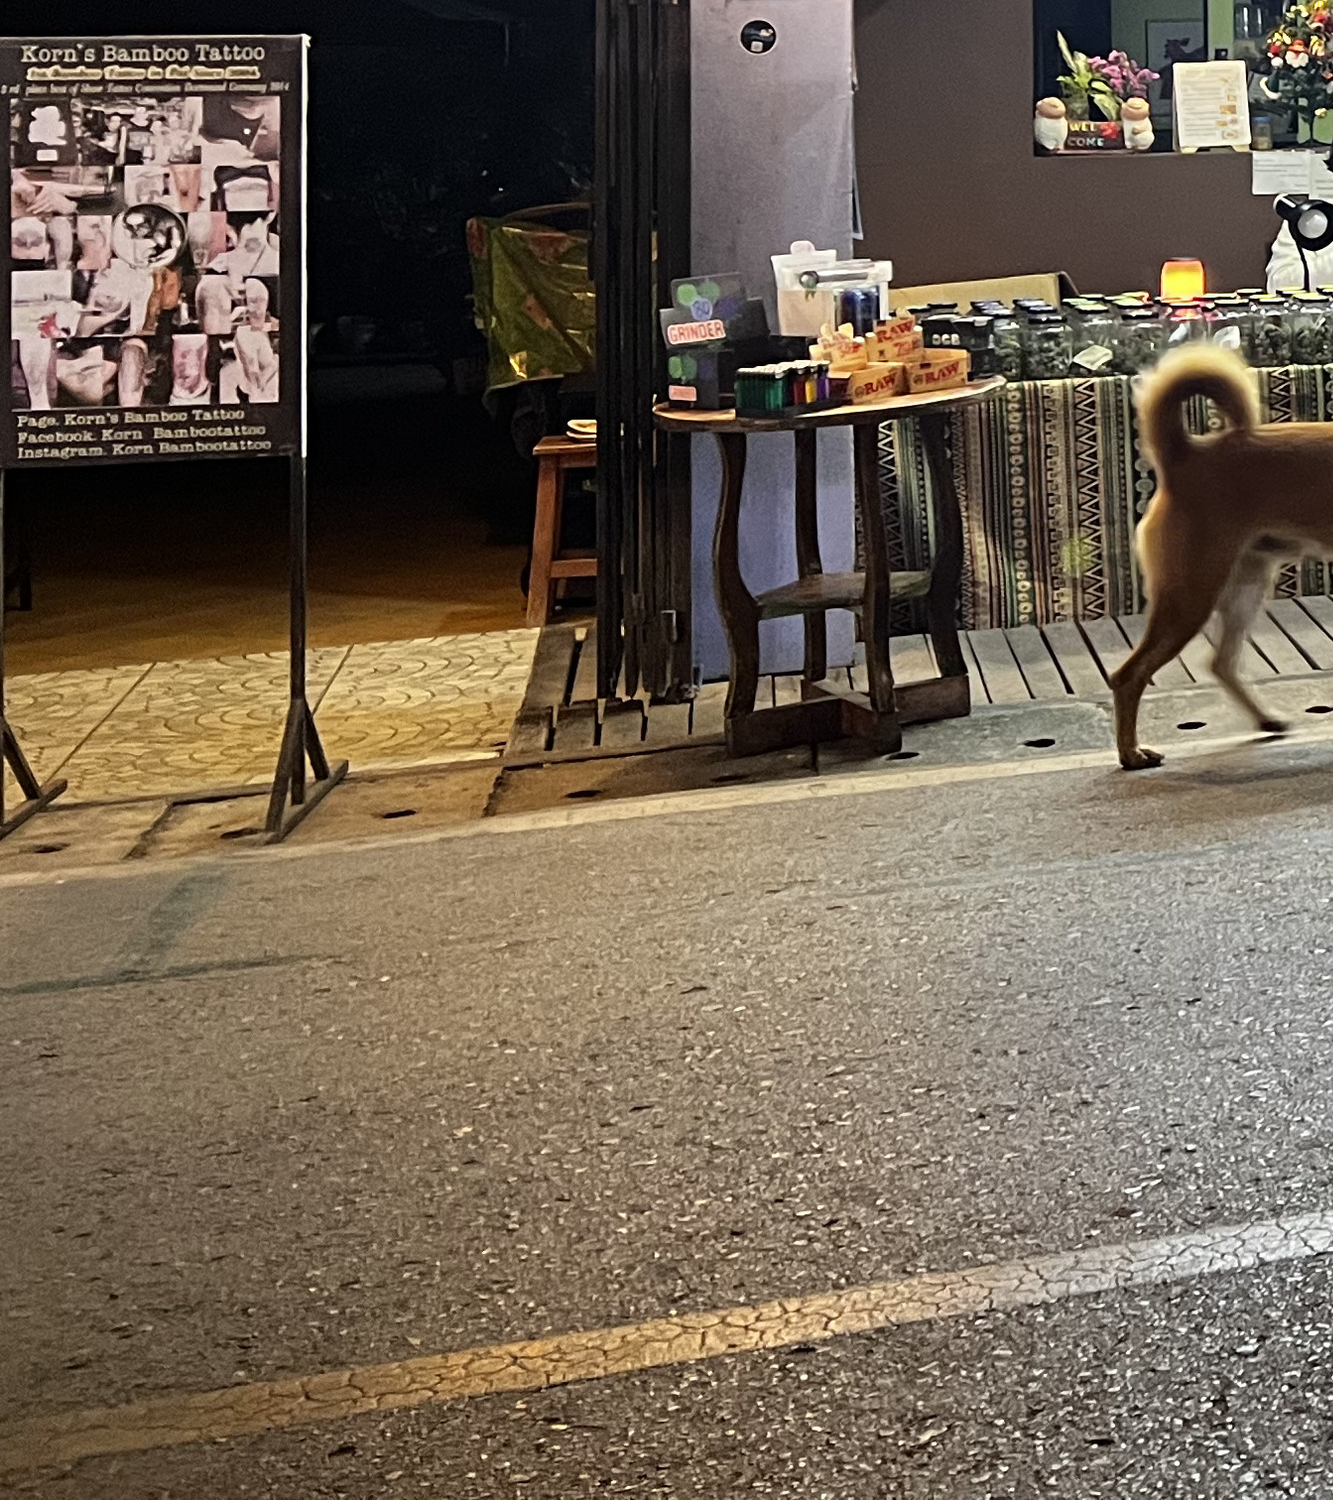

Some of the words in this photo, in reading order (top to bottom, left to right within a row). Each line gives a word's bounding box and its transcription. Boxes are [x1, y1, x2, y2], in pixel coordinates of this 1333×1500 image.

[20, 44, 95, 62] Korn's
[102, 45, 189, 62] Bamboo
[195, 44, 265, 62] Tattoo
[669, 321, 725, 342] GRINDER
[877, 321, 914, 343] RAW
[932, 333, 960, 346] OCB
[924, 362, 960, 383] RAW
[864, 373, 897, 396] RAW
[65, 412, 119, 426] Korn's
[124, 410, 188, 424] Bamboo
[192, 409, 245, 422] Tattoo
[101, 429, 143, 442] Korn
[112, 443, 153, 455] Korn
